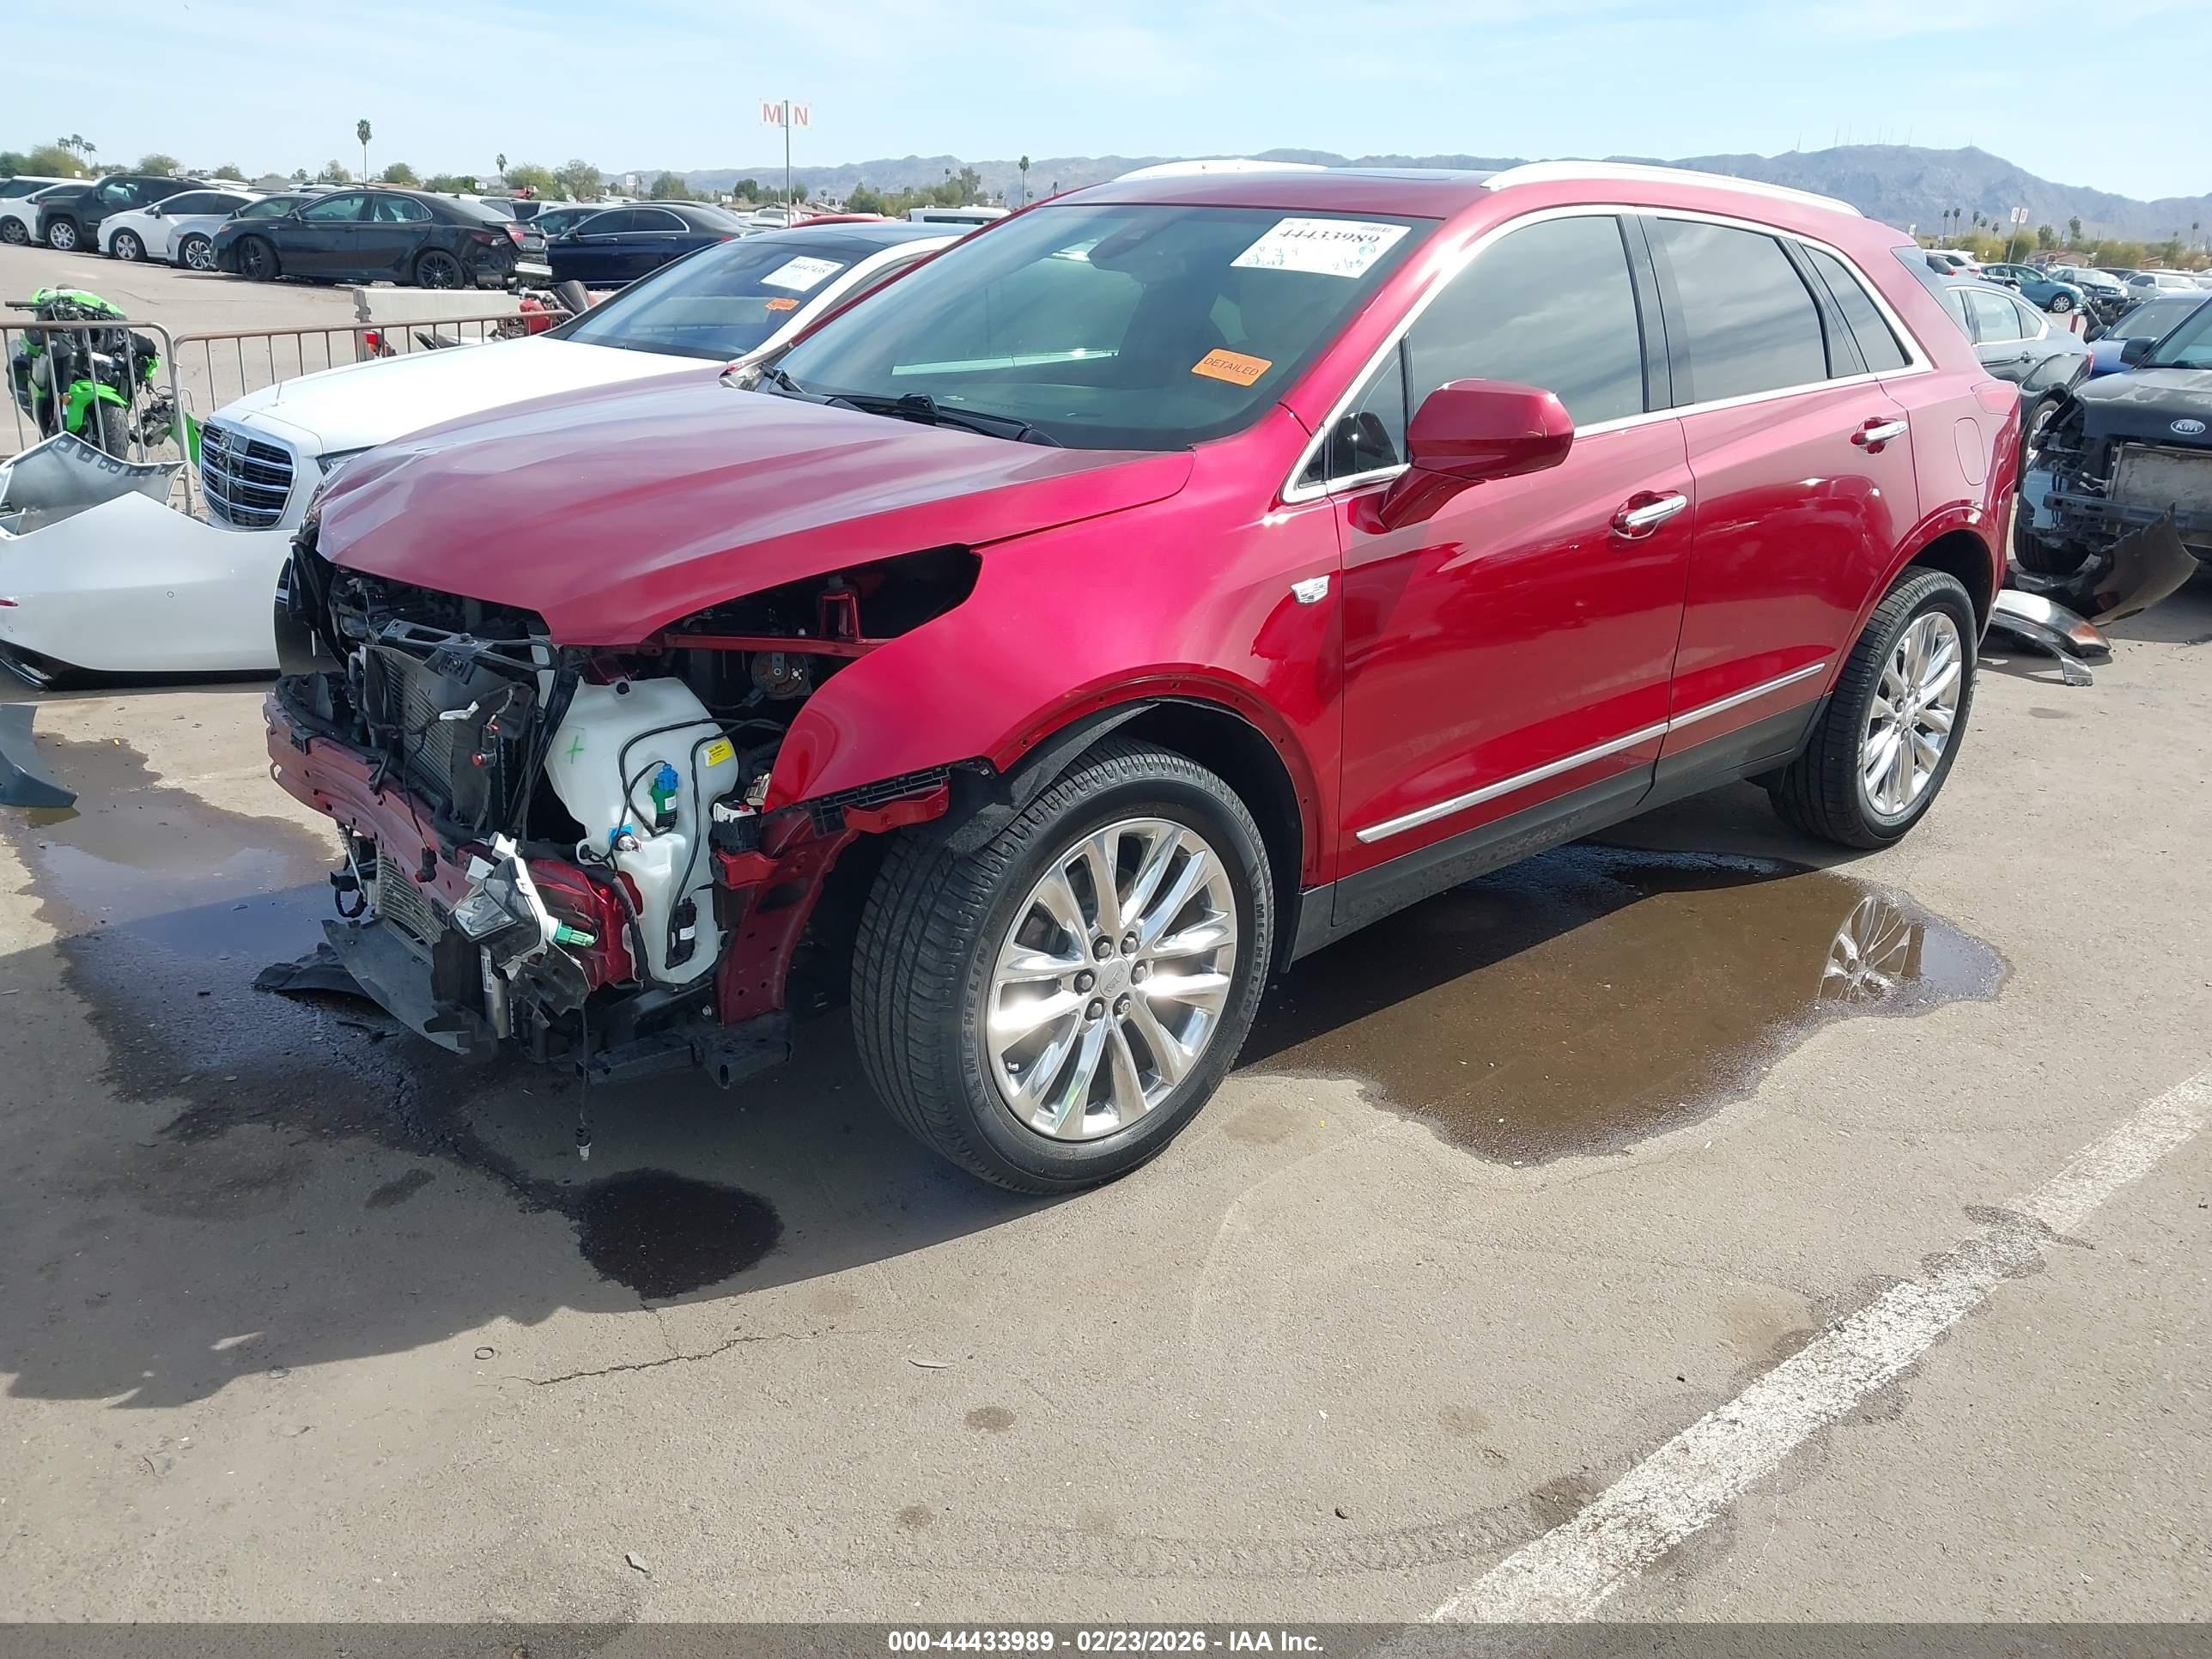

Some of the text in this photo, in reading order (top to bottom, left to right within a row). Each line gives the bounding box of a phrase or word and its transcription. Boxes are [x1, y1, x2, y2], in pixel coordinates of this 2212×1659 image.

[763, 103, 781, 123] M
[794, 106, 808, 125] N
[1279, 228, 1381, 243] 44433989
[1204, 357, 1259, 375] DETAILED
[2174, 421, 2199, 432] KIA
[1243, 903, 1266, 1012] MICHELIN
[963, 947, 988, 1074] MICHELIN
